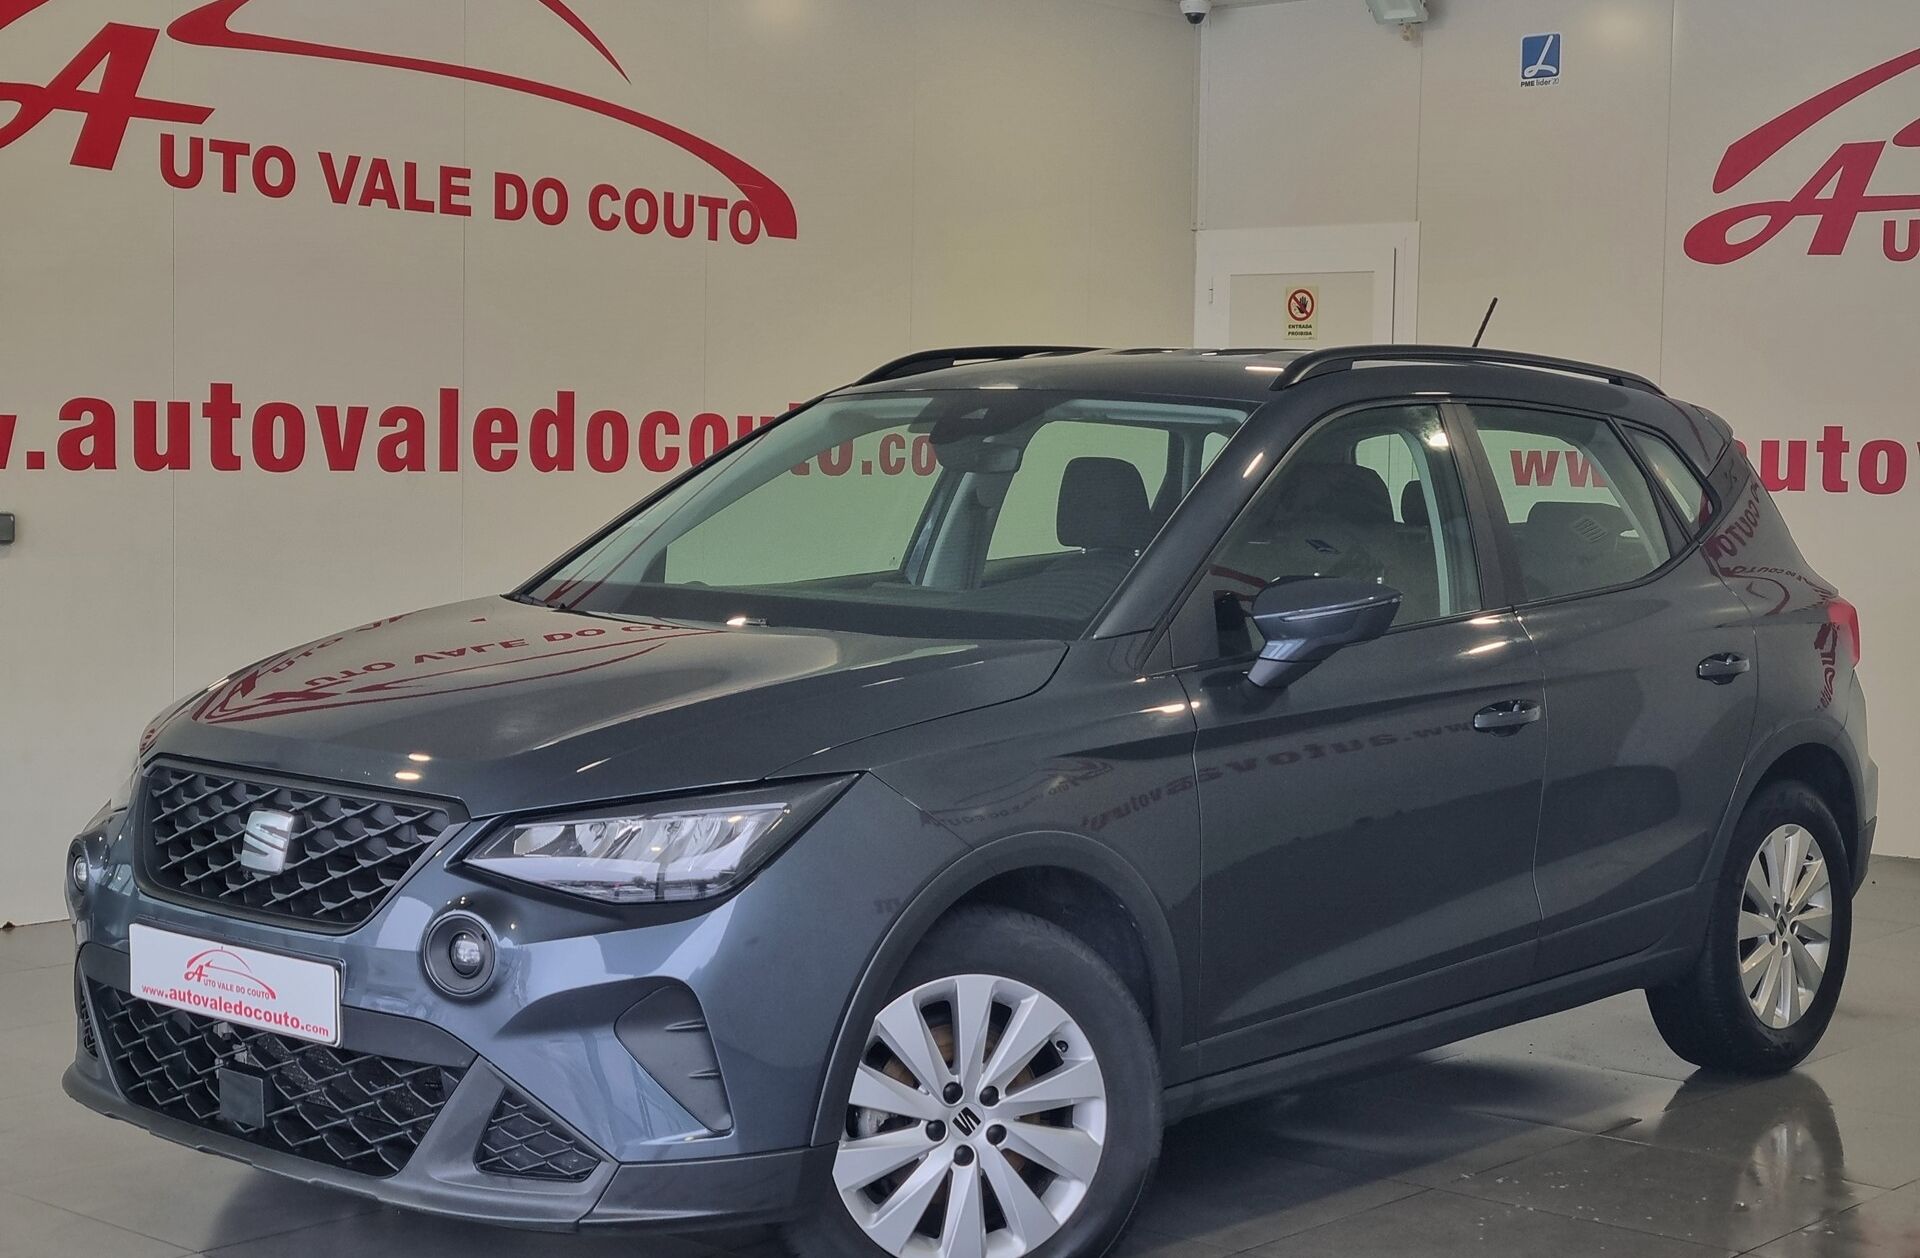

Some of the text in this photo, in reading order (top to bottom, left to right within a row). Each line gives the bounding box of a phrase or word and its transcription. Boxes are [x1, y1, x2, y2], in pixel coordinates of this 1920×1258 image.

[1520, 80, 1535, 88] PME
[318, 151, 473, 217] VALE
[493, 172, 570, 226] DO
[587, 183, 762, 245] COUTO
[217, 980, 235, 993] VALE
[235, 985, 246, 995] DO
[247, 987, 270, 1000] COUTO
[142, 983, 330, 1037] www.autovaledocouto.com
